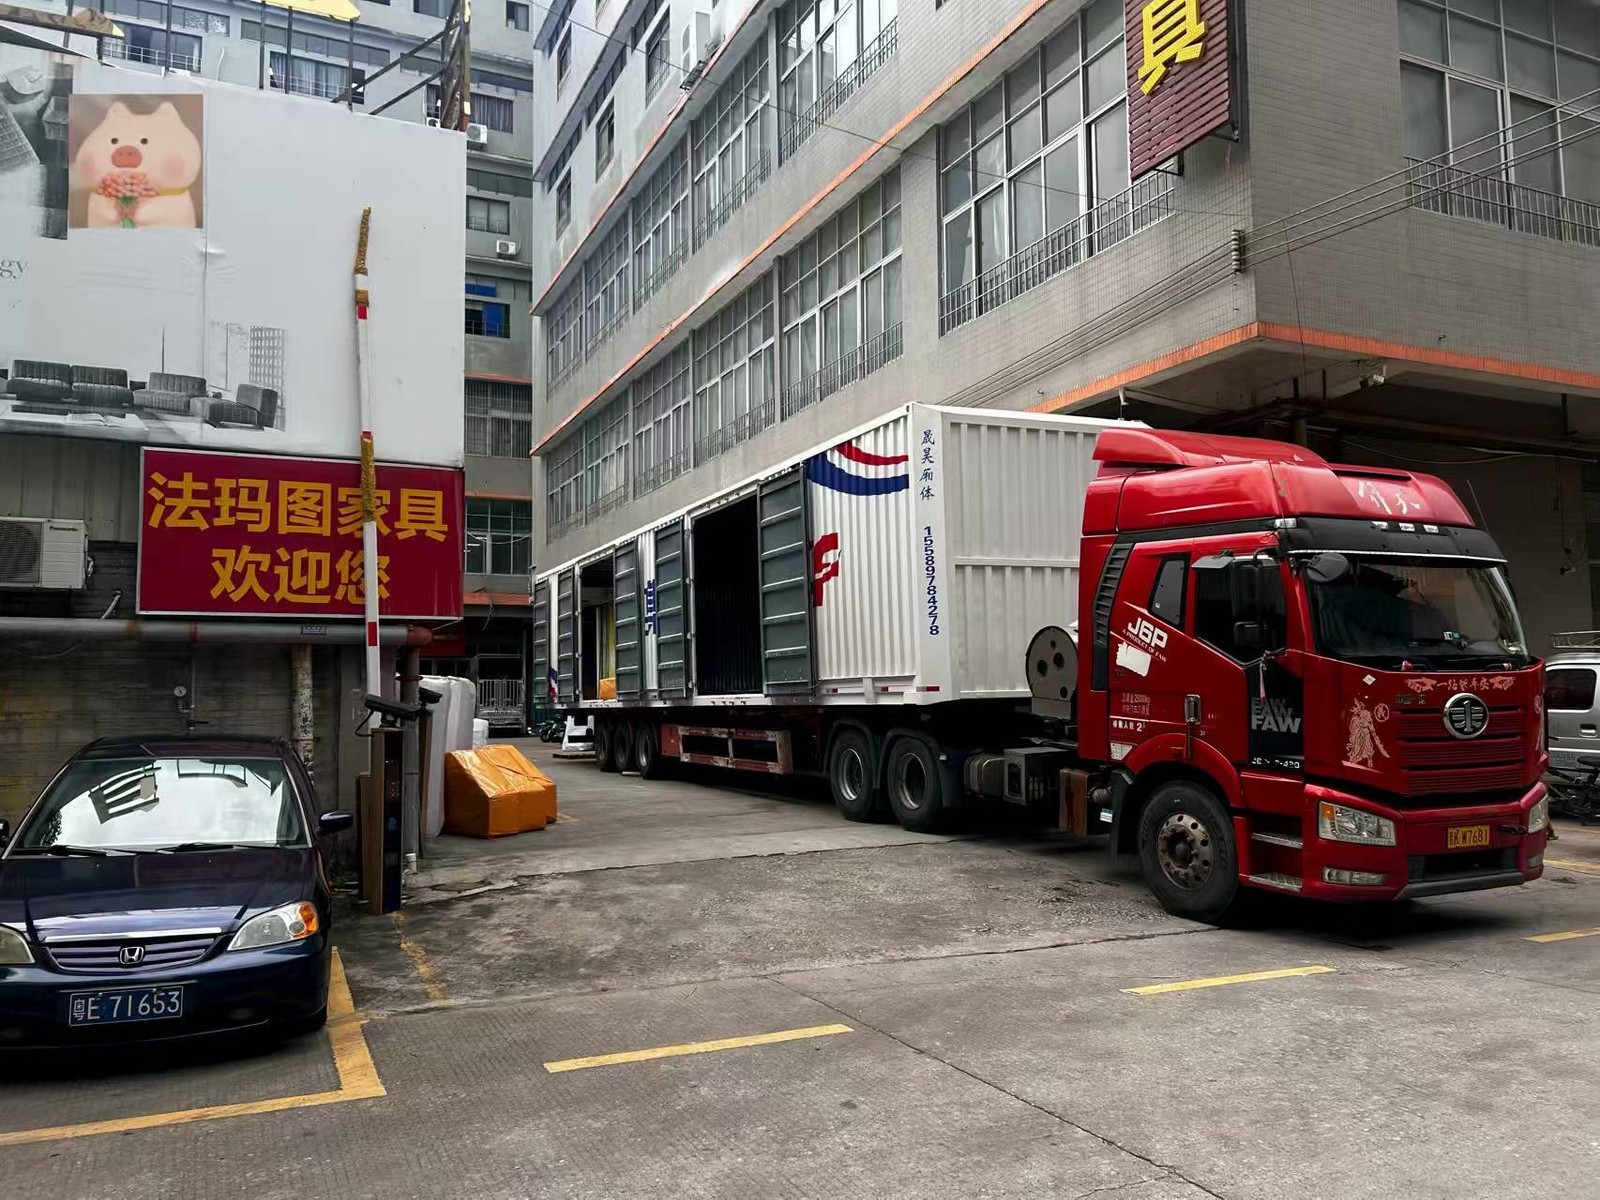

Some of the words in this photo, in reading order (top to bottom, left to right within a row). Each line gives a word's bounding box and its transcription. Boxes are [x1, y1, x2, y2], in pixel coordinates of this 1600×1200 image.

[1137, 0, 1207, 96] 具
[919, 429, 936, 500] 晟昊厢体
[148, 471, 449, 542] 法玛图家具
[209, 544, 391, 605] 欢迎您
[923, 525, 940, 635] 15589784278
[1127, 616, 1168, 649] J6P
[1250, 714, 1302, 734] FAW
